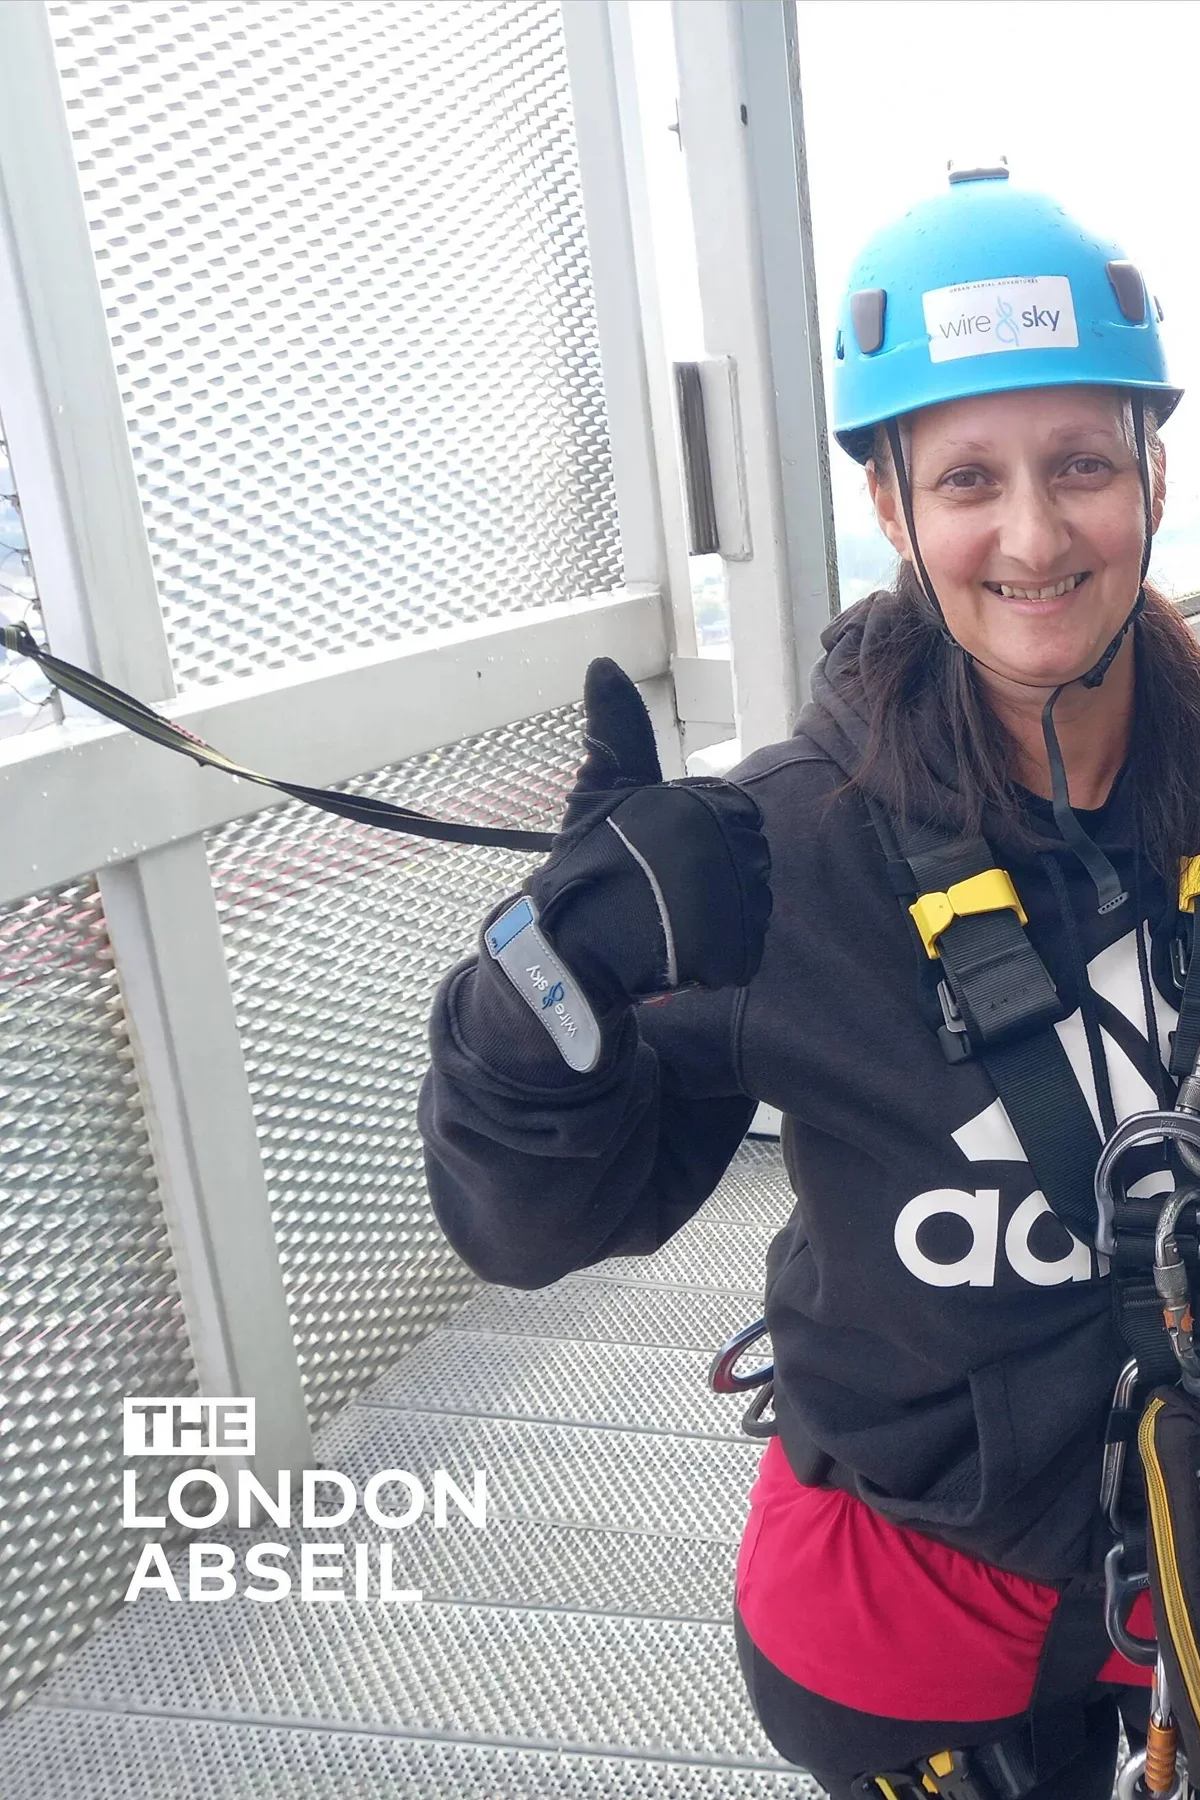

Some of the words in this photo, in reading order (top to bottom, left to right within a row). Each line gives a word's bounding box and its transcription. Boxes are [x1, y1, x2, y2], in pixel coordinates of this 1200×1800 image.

[949, 285, 970, 293] URBAN
[939, 313, 991, 339] wire
[1022, 305, 1060, 331] sky
[525, 964, 549, 991] sky
[554, 1003, 578, 1038] wire
